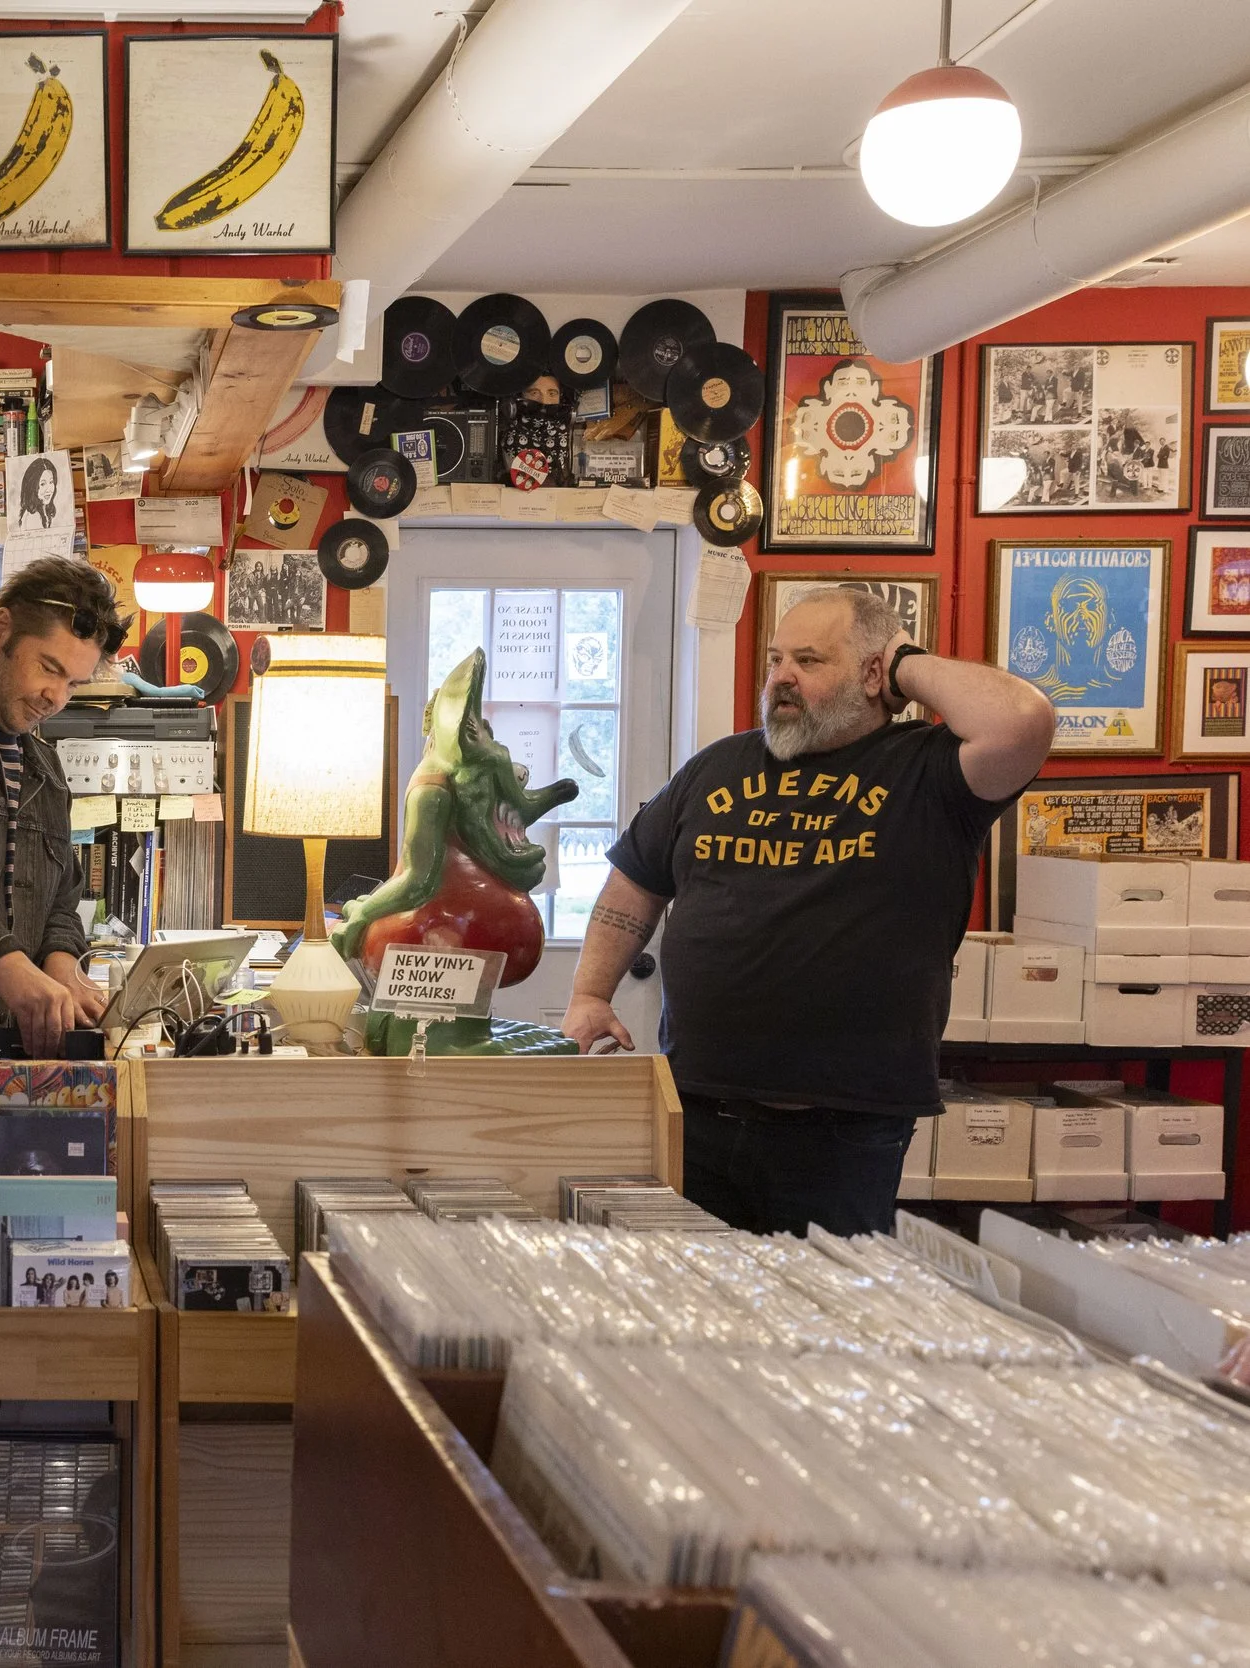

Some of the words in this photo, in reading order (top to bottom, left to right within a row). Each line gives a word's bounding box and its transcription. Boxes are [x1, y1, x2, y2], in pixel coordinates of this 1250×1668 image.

[27, 219, 70, 236] Warhol
[213, 222, 248, 241] Andy
[251, 221, 295, 240] Warhol
[281, 453, 302, 465] Andy
[304, 453, 330, 465] Warhol
[283, 475, 306, 497] Solo
[604, 472, 627, 484] BEATLES
[834, 496, 865, 520] KING
[707, 549, 728, 559] MUSIC
[1079, 550, 1151, 568] ELEVATORS
[90, 560, 124, 586] rdiscs
[1055, 716, 1108, 729] VALON
[706, 768, 890, 818] QUEENS
[1045, 797, 1060, 806] HEY
[1061, 797, 1081, 805] BUD!
[1081, 796, 1096, 805] GET
[1097, 796, 1116, 805] THESE
[1116, 796, 1144, 805] ALBUMS!
[1147, 795, 1168, 803] BACK
[1177, 794, 1204, 803] GRAVE
[747, 809, 782, 827] OF
[790, 811, 838, 832] THE
[94, 844, 102, 866] PLEASE
[111, 831, 119, 868] ARCHIVIST
[694, 833, 805, 867] STONE
[813, 830, 877, 866] AGE
[92, 866, 102, 889] KILL
[394, 953, 431, 968] NEW
[434, 956, 475, 972] VINYL
[391, 968, 410, 982] IS
[413, 969, 445, 983] NOW
[388, 983, 456, 1001] UPSTAIRS!
[47, 1258, 66, 1266] Wild
[67, 1258, 94, 1266] Horses
[0, 1626, 47, 1647] ALBUM
[49, 1628, 98, 1649] FRAME
[3, 1649, 23, 1660] YOUR
[23, 1650, 50, 1661] RECORD
[51, 1650, 76, 1661] ALBUMS
[76, 1651, 86, 1661] AS
[87, 1651, 102, 1662] ART
